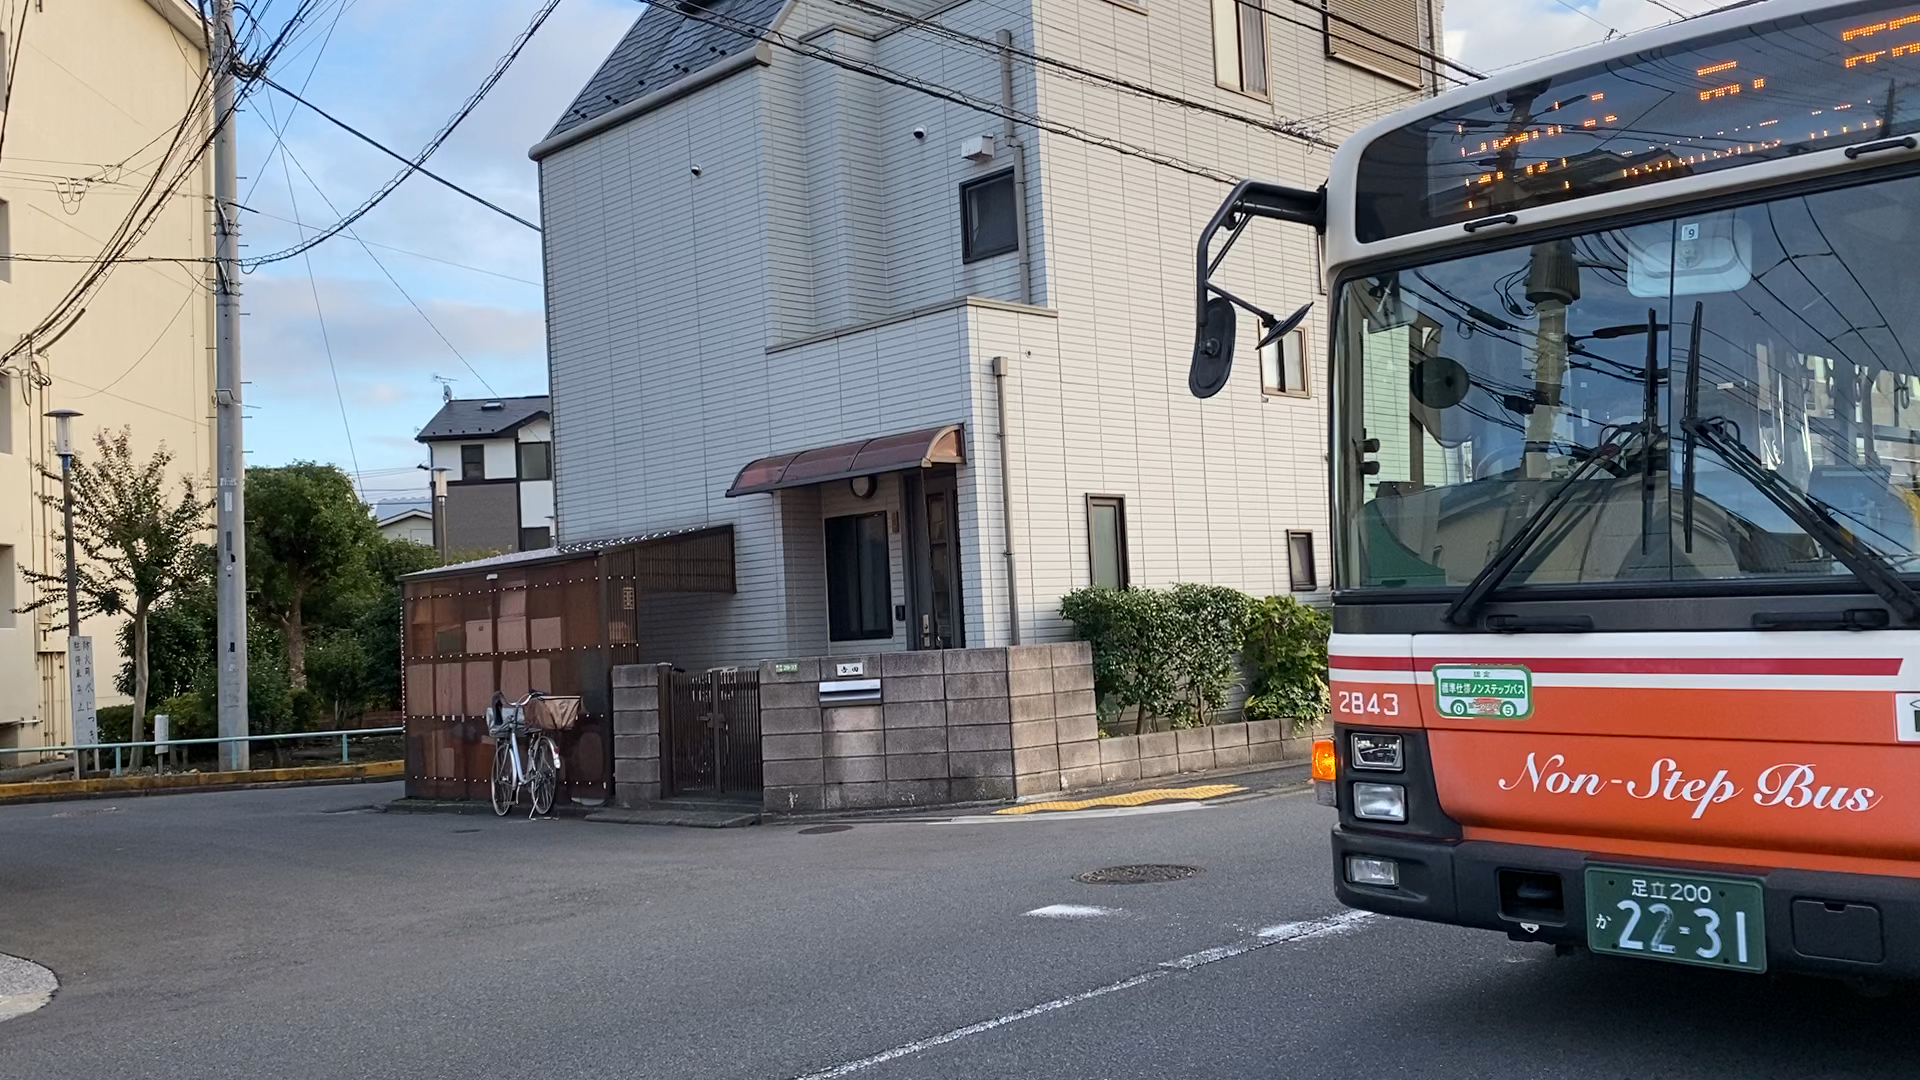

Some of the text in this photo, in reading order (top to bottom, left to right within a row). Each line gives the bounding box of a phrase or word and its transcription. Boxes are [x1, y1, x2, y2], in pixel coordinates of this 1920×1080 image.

[1338, 691, 1399, 716] 2843
[1498, 752, 1884, 820] Non-Step Bus
[1596, 899, 1748, 963] か 22-31
